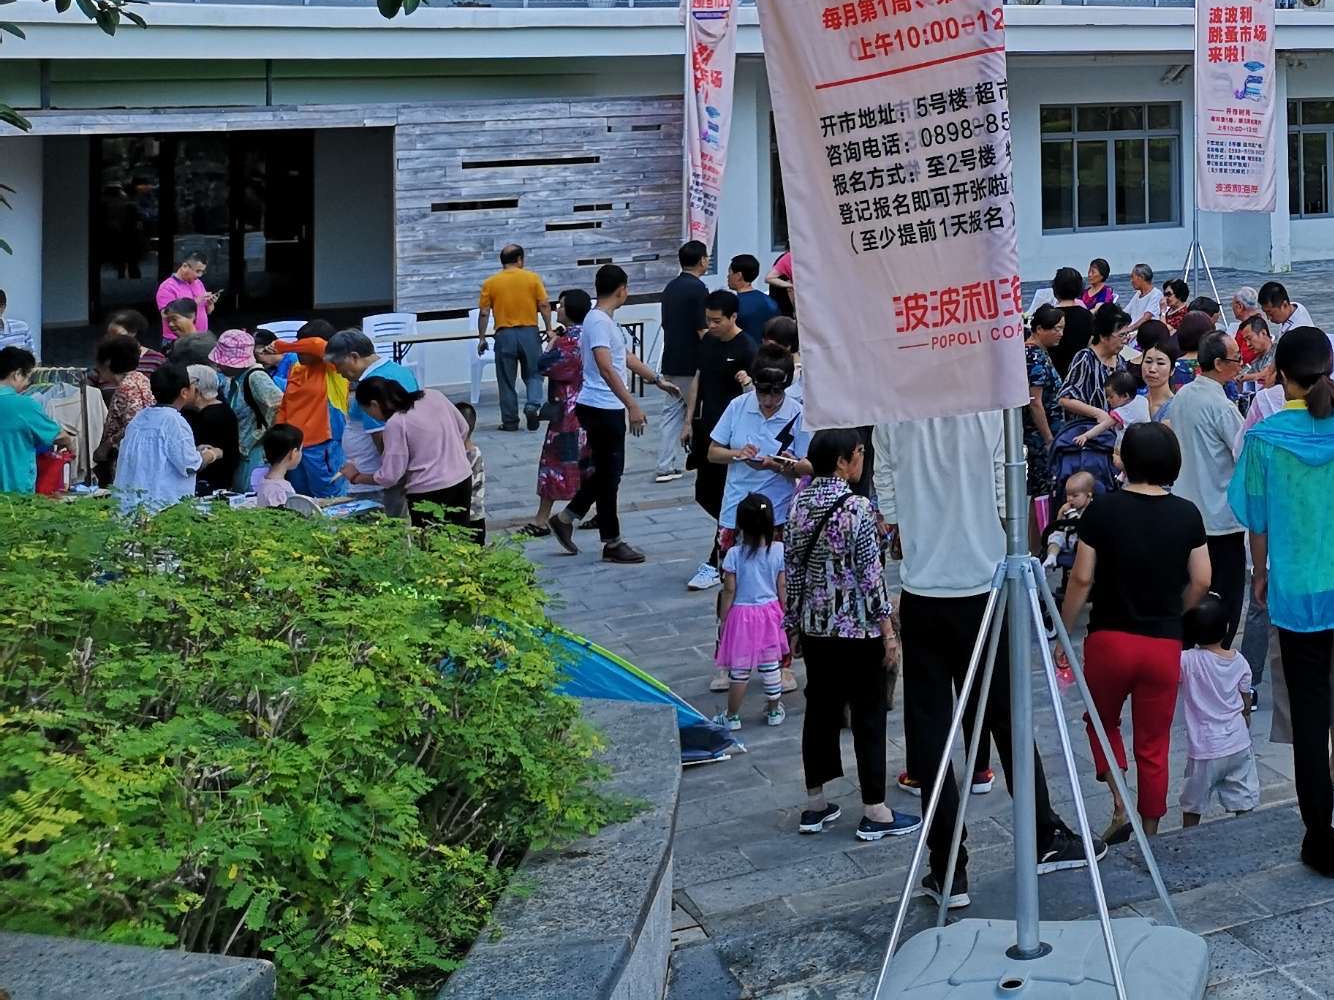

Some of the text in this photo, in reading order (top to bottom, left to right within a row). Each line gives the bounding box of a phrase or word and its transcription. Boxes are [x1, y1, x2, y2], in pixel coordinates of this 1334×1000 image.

[1208, 6, 1253, 25] 波波利
[1207, 24, 1267, 43] 跳蚤市场
[1207, 45, 1246, 63] 来啦！
[931, 331, 982, 351] POPOLI
